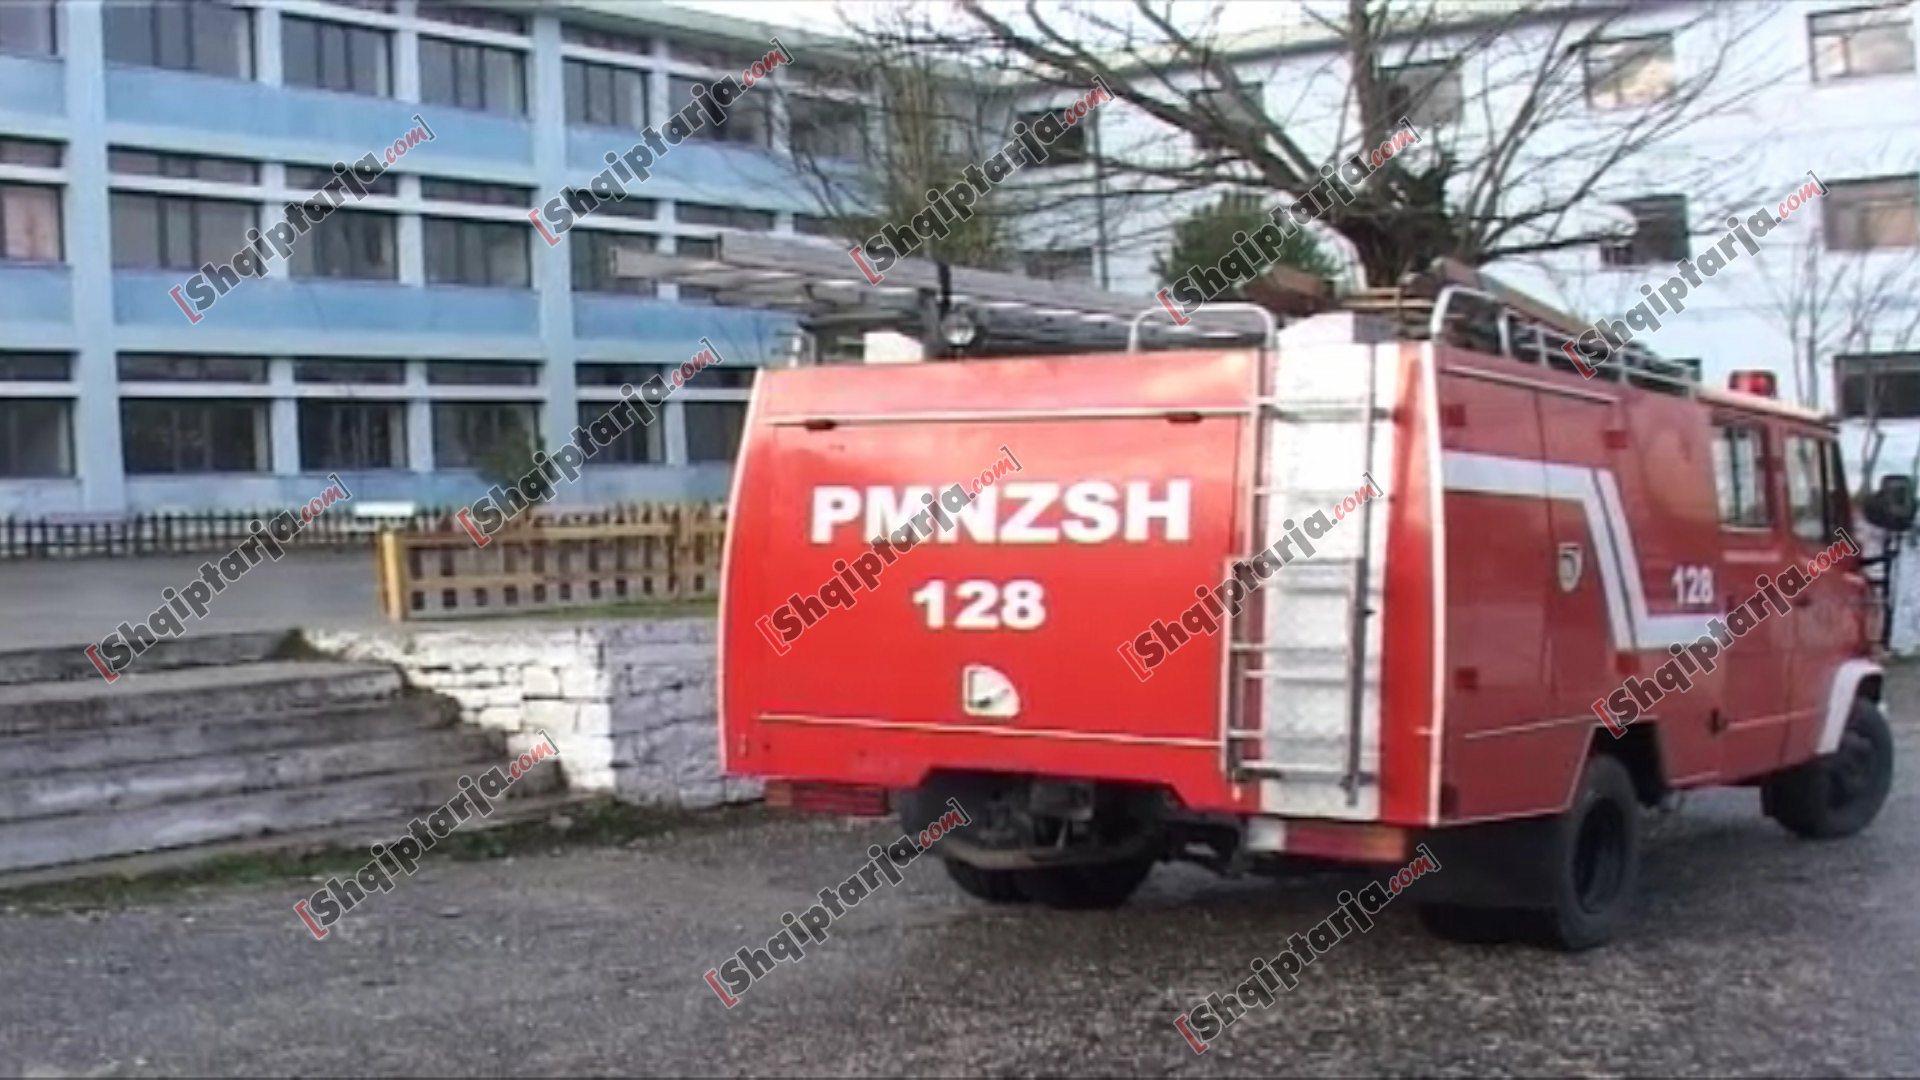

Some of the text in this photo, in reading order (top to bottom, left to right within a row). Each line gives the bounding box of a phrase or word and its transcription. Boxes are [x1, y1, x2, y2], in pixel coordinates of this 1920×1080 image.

[811, 480, 1191, 544] PMNZSH
[913, 580, 1047, 630] 128
[1671, 565, 1716, 605] 128
